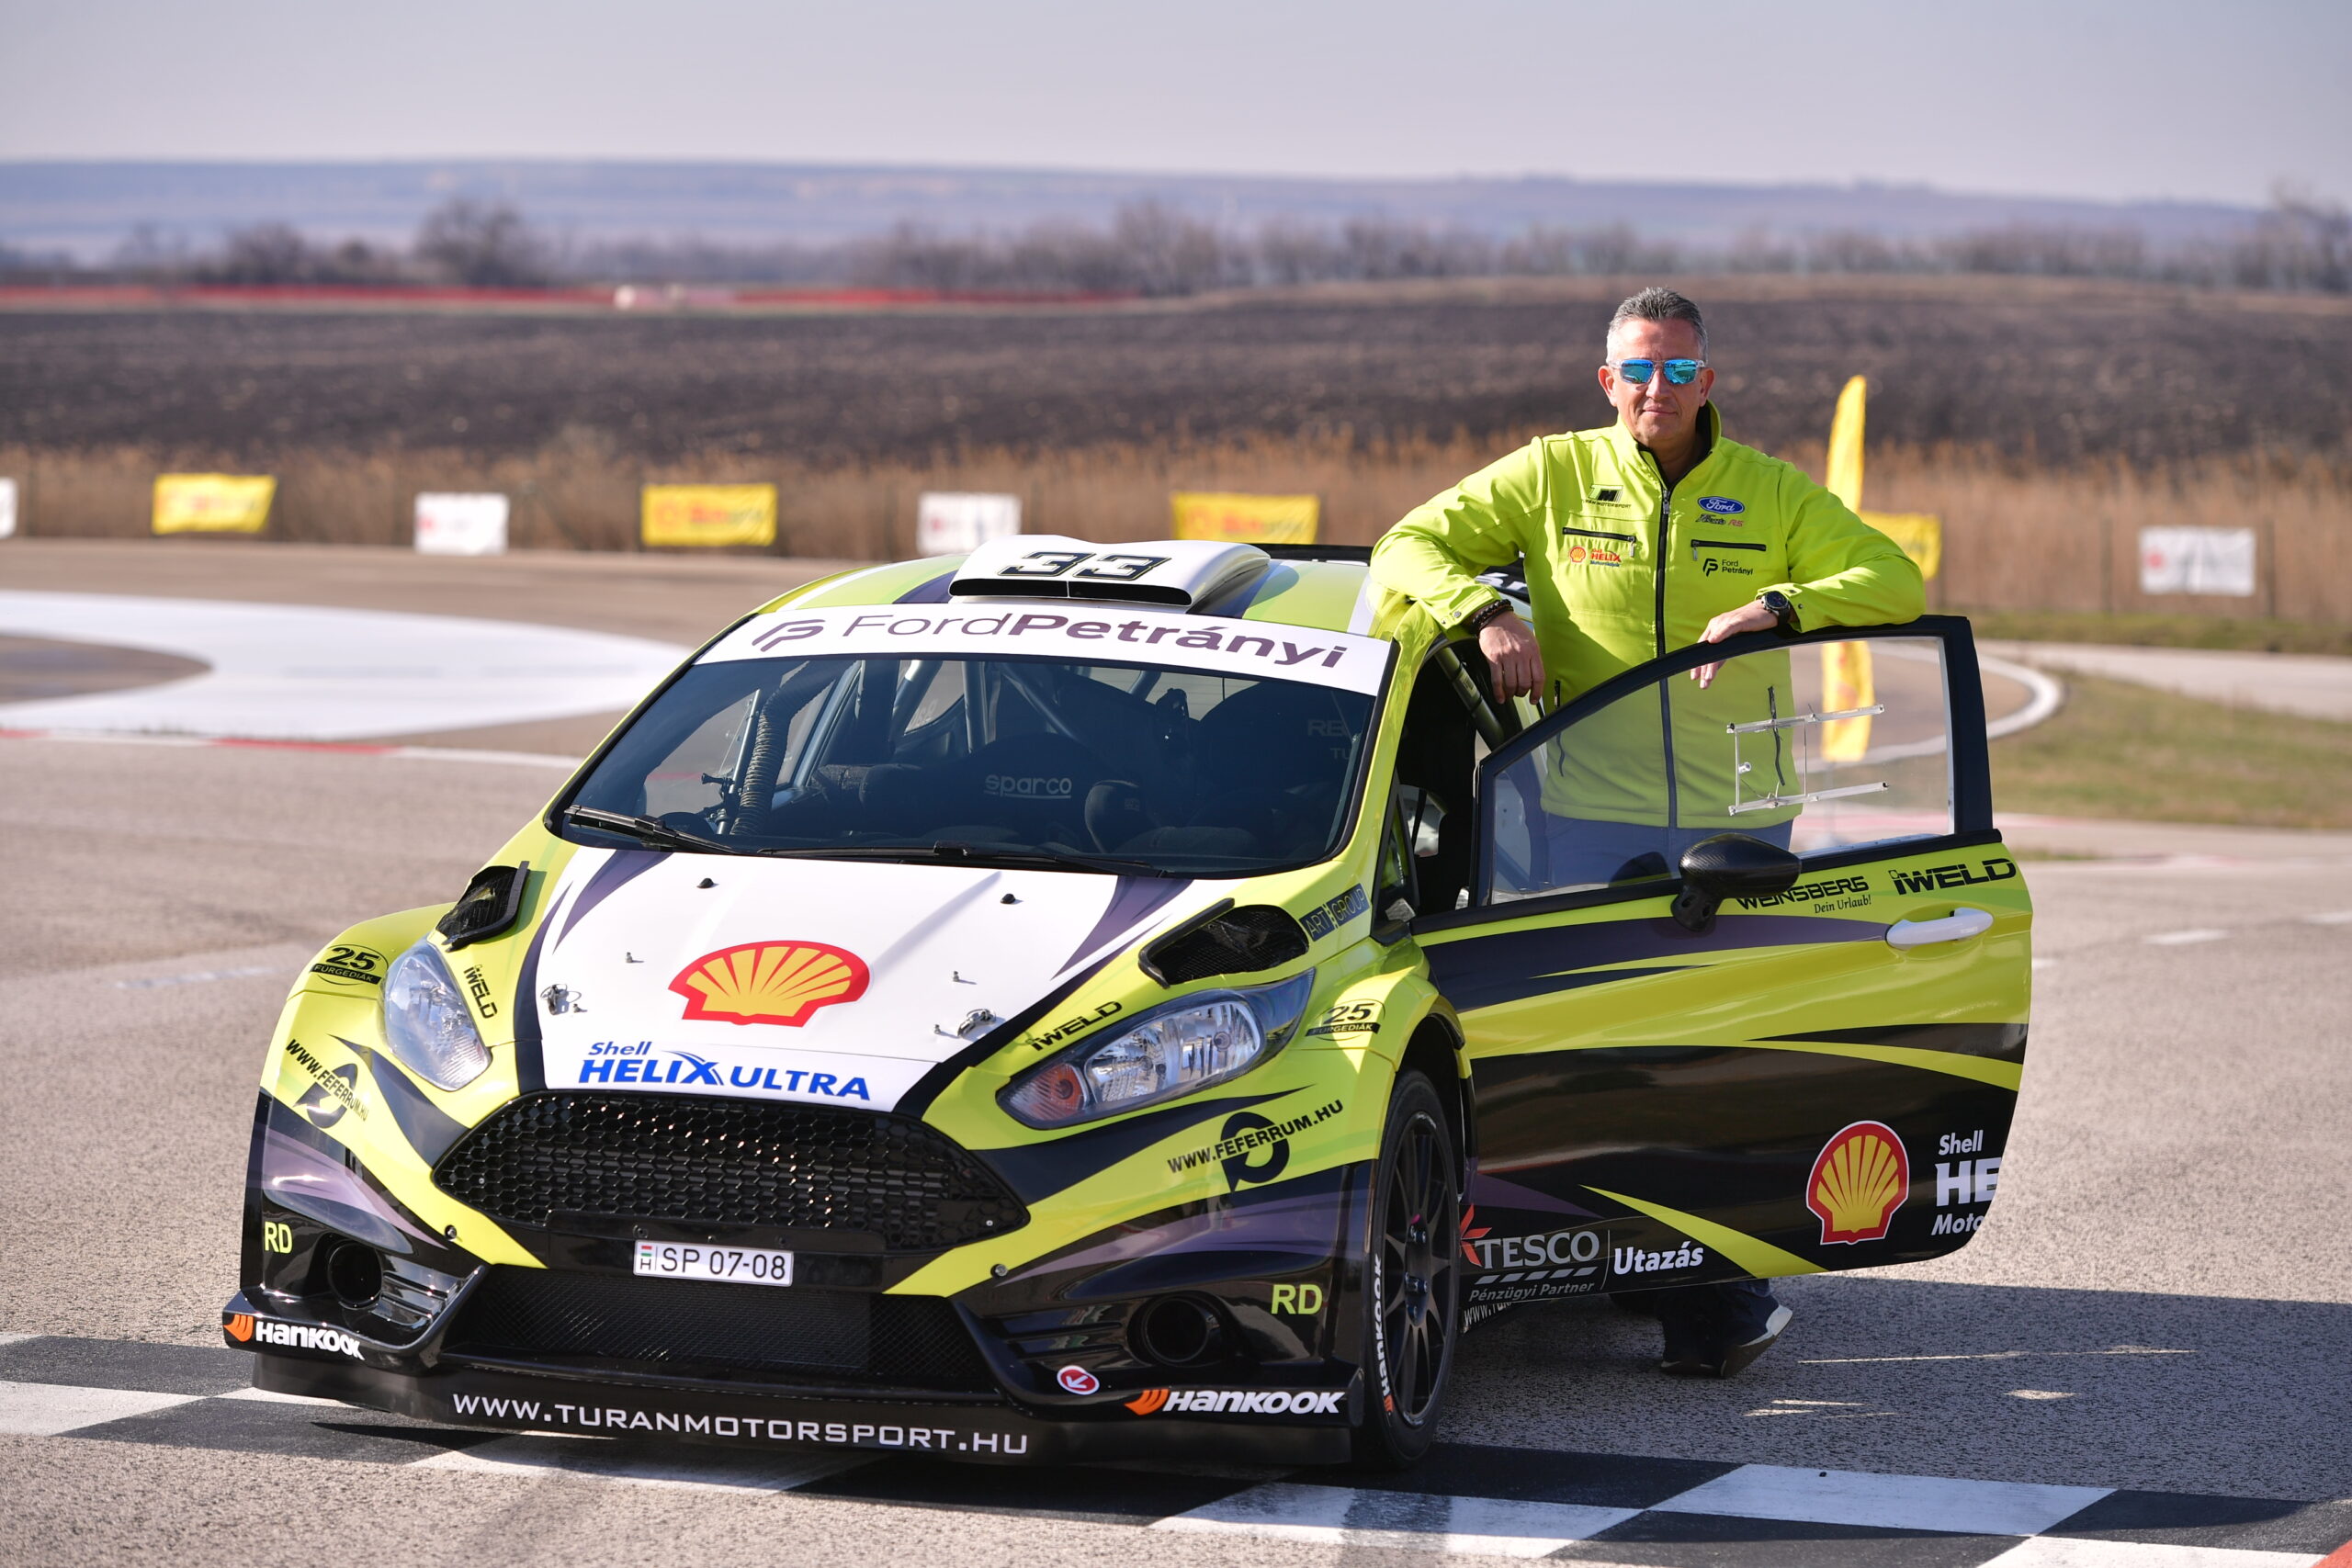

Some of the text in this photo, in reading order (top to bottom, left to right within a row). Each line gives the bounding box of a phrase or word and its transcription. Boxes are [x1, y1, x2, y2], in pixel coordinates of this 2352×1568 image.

[1706, 499, 1735, 512] Ford
[997, 551, 1172, 581] 33
[1590, 551, 1622, 562] HELIX
[1722, 566, 1754, 576] Petrányi
[985, 774, 1072, 796] sparco
[1306, 888, 1365, 938] ART GROUP
[1814, 895, 1871, 914] Dein Urlaub!
[326, 947, 380, 970] 25
[1323, 1002, 1376, 1025] 25
[588, 1041, 651, 1055] Shell
[578, 1051, 871, 1101] HELIX ULTRA
[1167, 1100, 1345, 1175] WWW.FEFERRUM.HU
[1939, 1129, 1984, 1156] Shell
[264, 1221, 292, 1254] RD
[1475, 1230, 1600, 1269] TESCO
[639, 1258, 652, 1270] H
[661, 1247, 786, 1280] SP 07-08
[1612, 1240, 1704, 1275] Utazás
[1271, 1283, 1324, 1315] RD
[1468, 1282, 1595, 1303] Pénzügyi Partner
[452, 1393, 1028, 1454] WWW.TURANMOTORSPORT.HU
